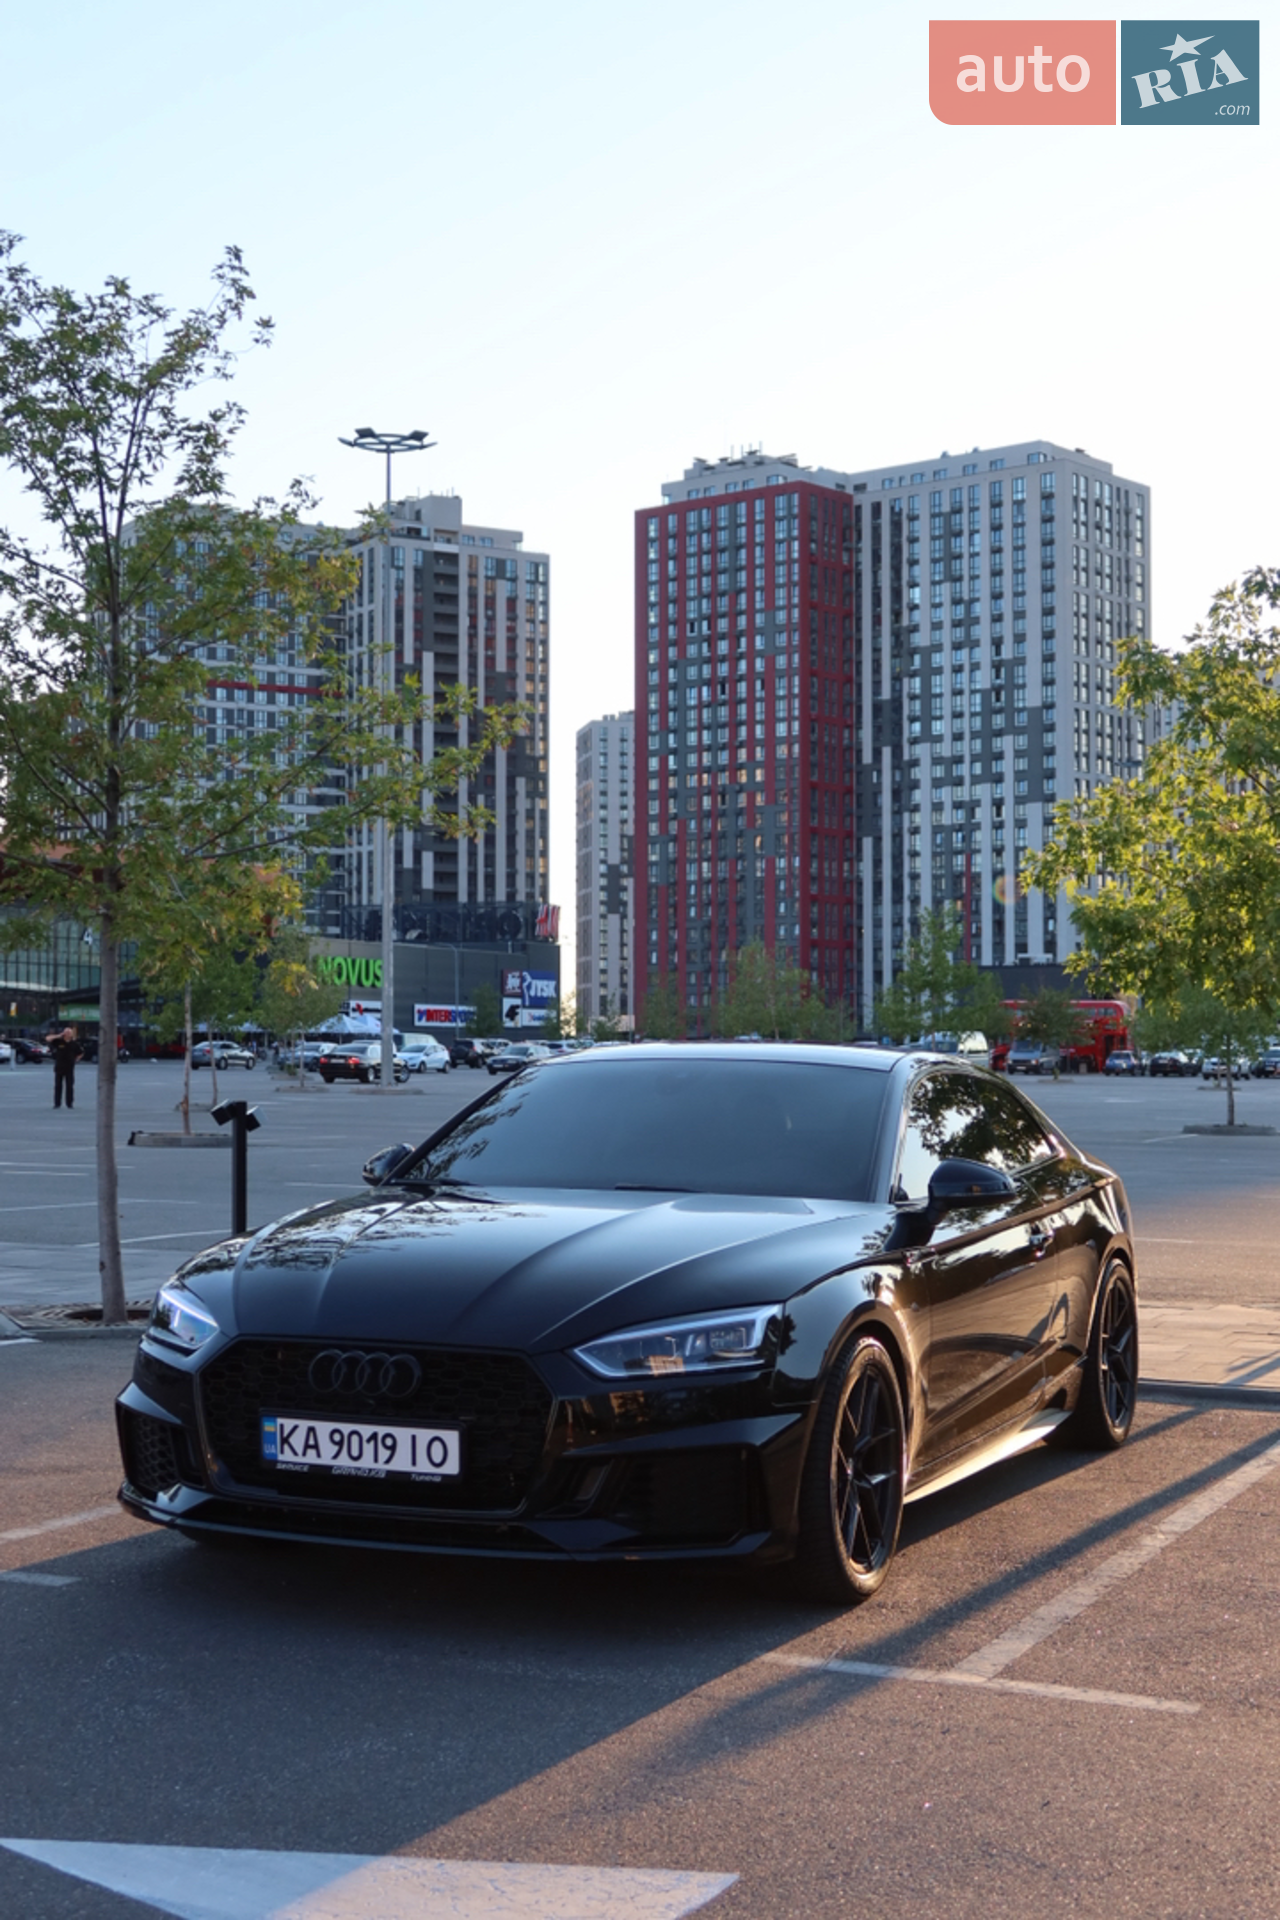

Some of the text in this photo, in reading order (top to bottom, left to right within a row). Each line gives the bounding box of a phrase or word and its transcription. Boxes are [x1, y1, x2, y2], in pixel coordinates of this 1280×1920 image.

[317, 955, 383, 988] NOVUS
[529, 979, 556, 997] JYSK
[264, 1443, 277, 1454] UA
[279, 1423, 448, 1468] KA 9019 IO
